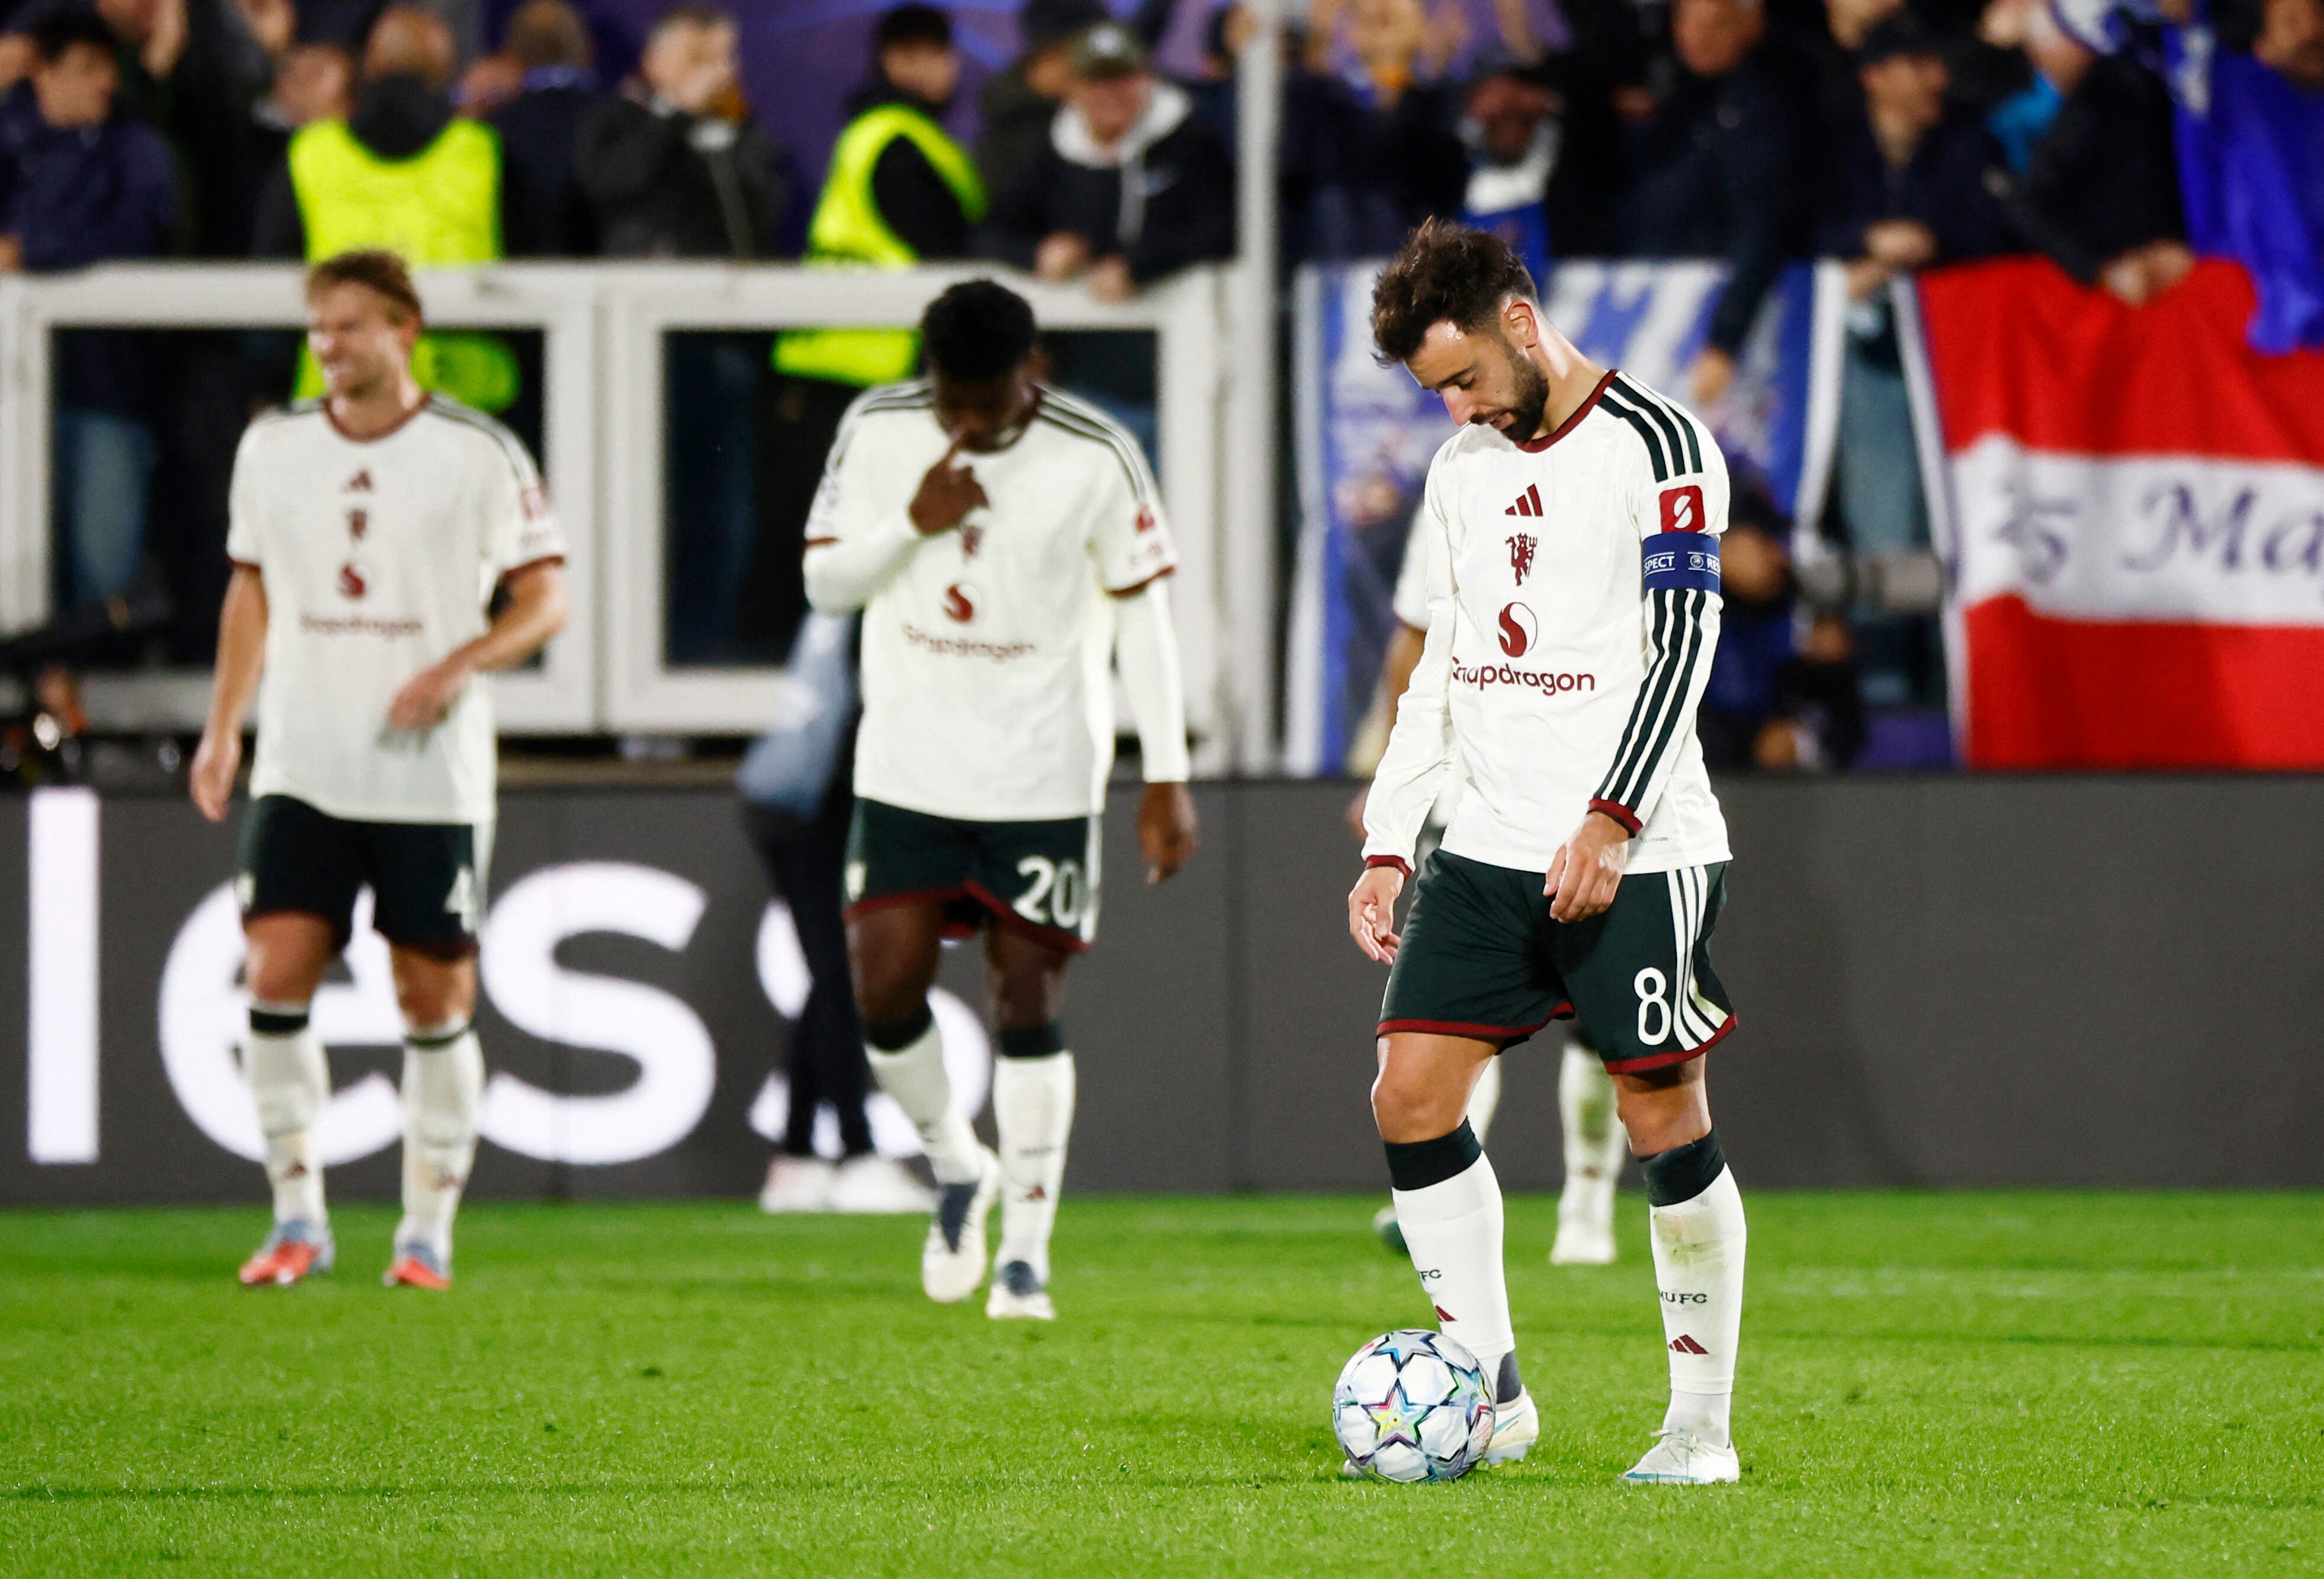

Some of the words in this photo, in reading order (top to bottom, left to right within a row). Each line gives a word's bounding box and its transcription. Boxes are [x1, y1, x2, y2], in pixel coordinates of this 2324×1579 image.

[444, 866, 475, 934] 4
[1012, 855, 1080, 928] 20
[1634, 966, 1671, 1046] 8
